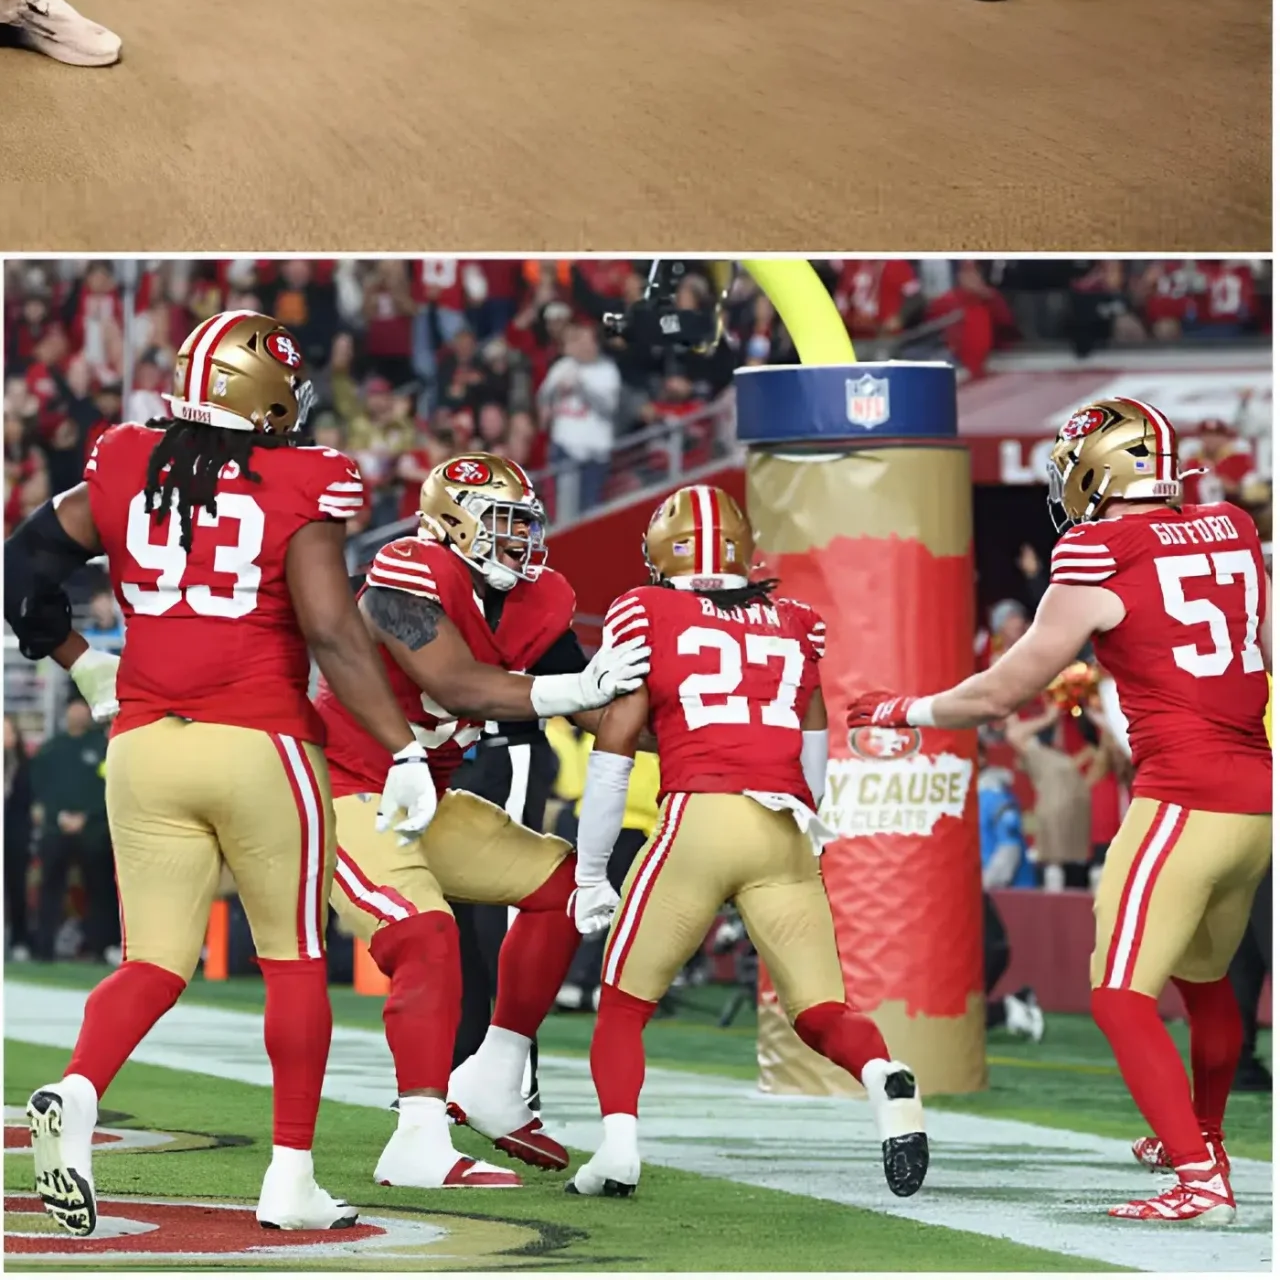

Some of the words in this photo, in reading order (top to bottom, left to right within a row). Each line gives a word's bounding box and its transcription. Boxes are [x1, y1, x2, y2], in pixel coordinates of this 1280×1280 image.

[121, 486, 266, 619] 93
[1149, 516, 1239, 546] GIFFORD
[1153, 548, 1265, 678] 57
[677, 626, 806, 730] 27
[857, 772, 961, 805] CAUSE
